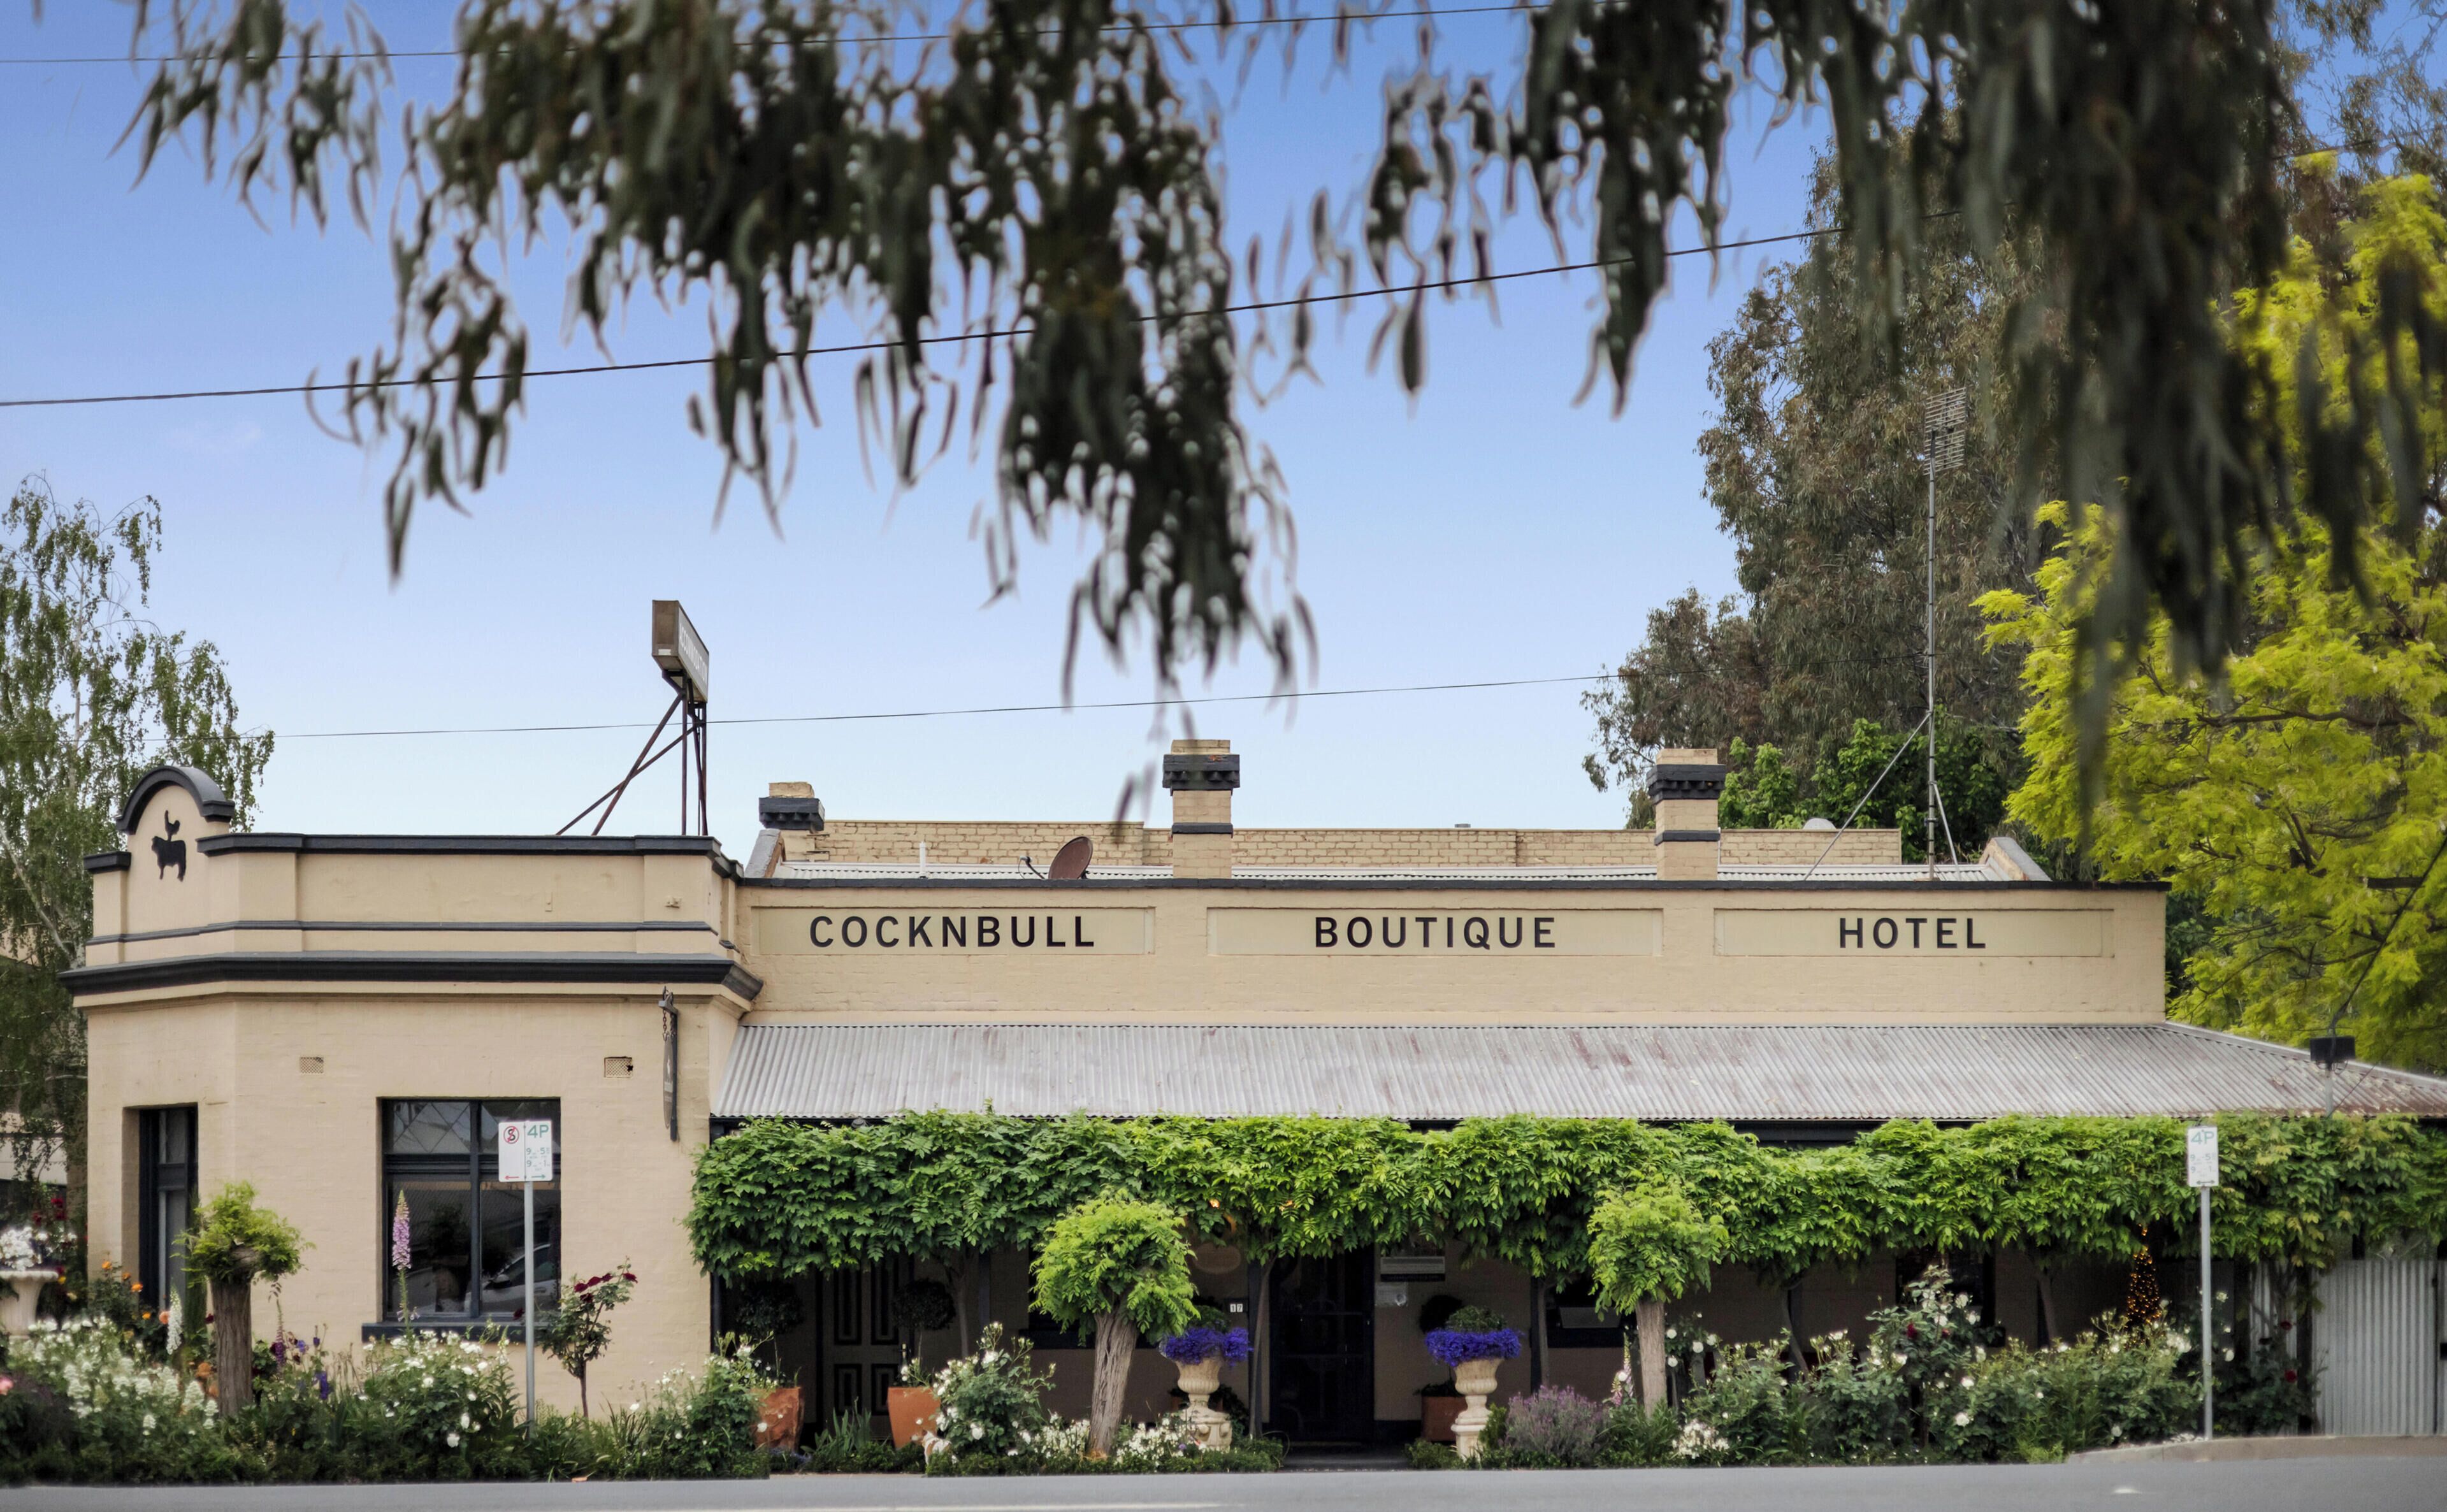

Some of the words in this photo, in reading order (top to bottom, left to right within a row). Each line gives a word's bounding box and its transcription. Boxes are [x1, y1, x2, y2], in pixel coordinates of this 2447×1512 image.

[809, 916, 1095, 948] COCKNBULL
[1315, 917, 1556, 950] BOUTIQUE
[1839, 918, 1986, 949] HOTEL
[527, 1125, 549, 1138] 4P
[2191, 1131, 2214, 1144] 4P
